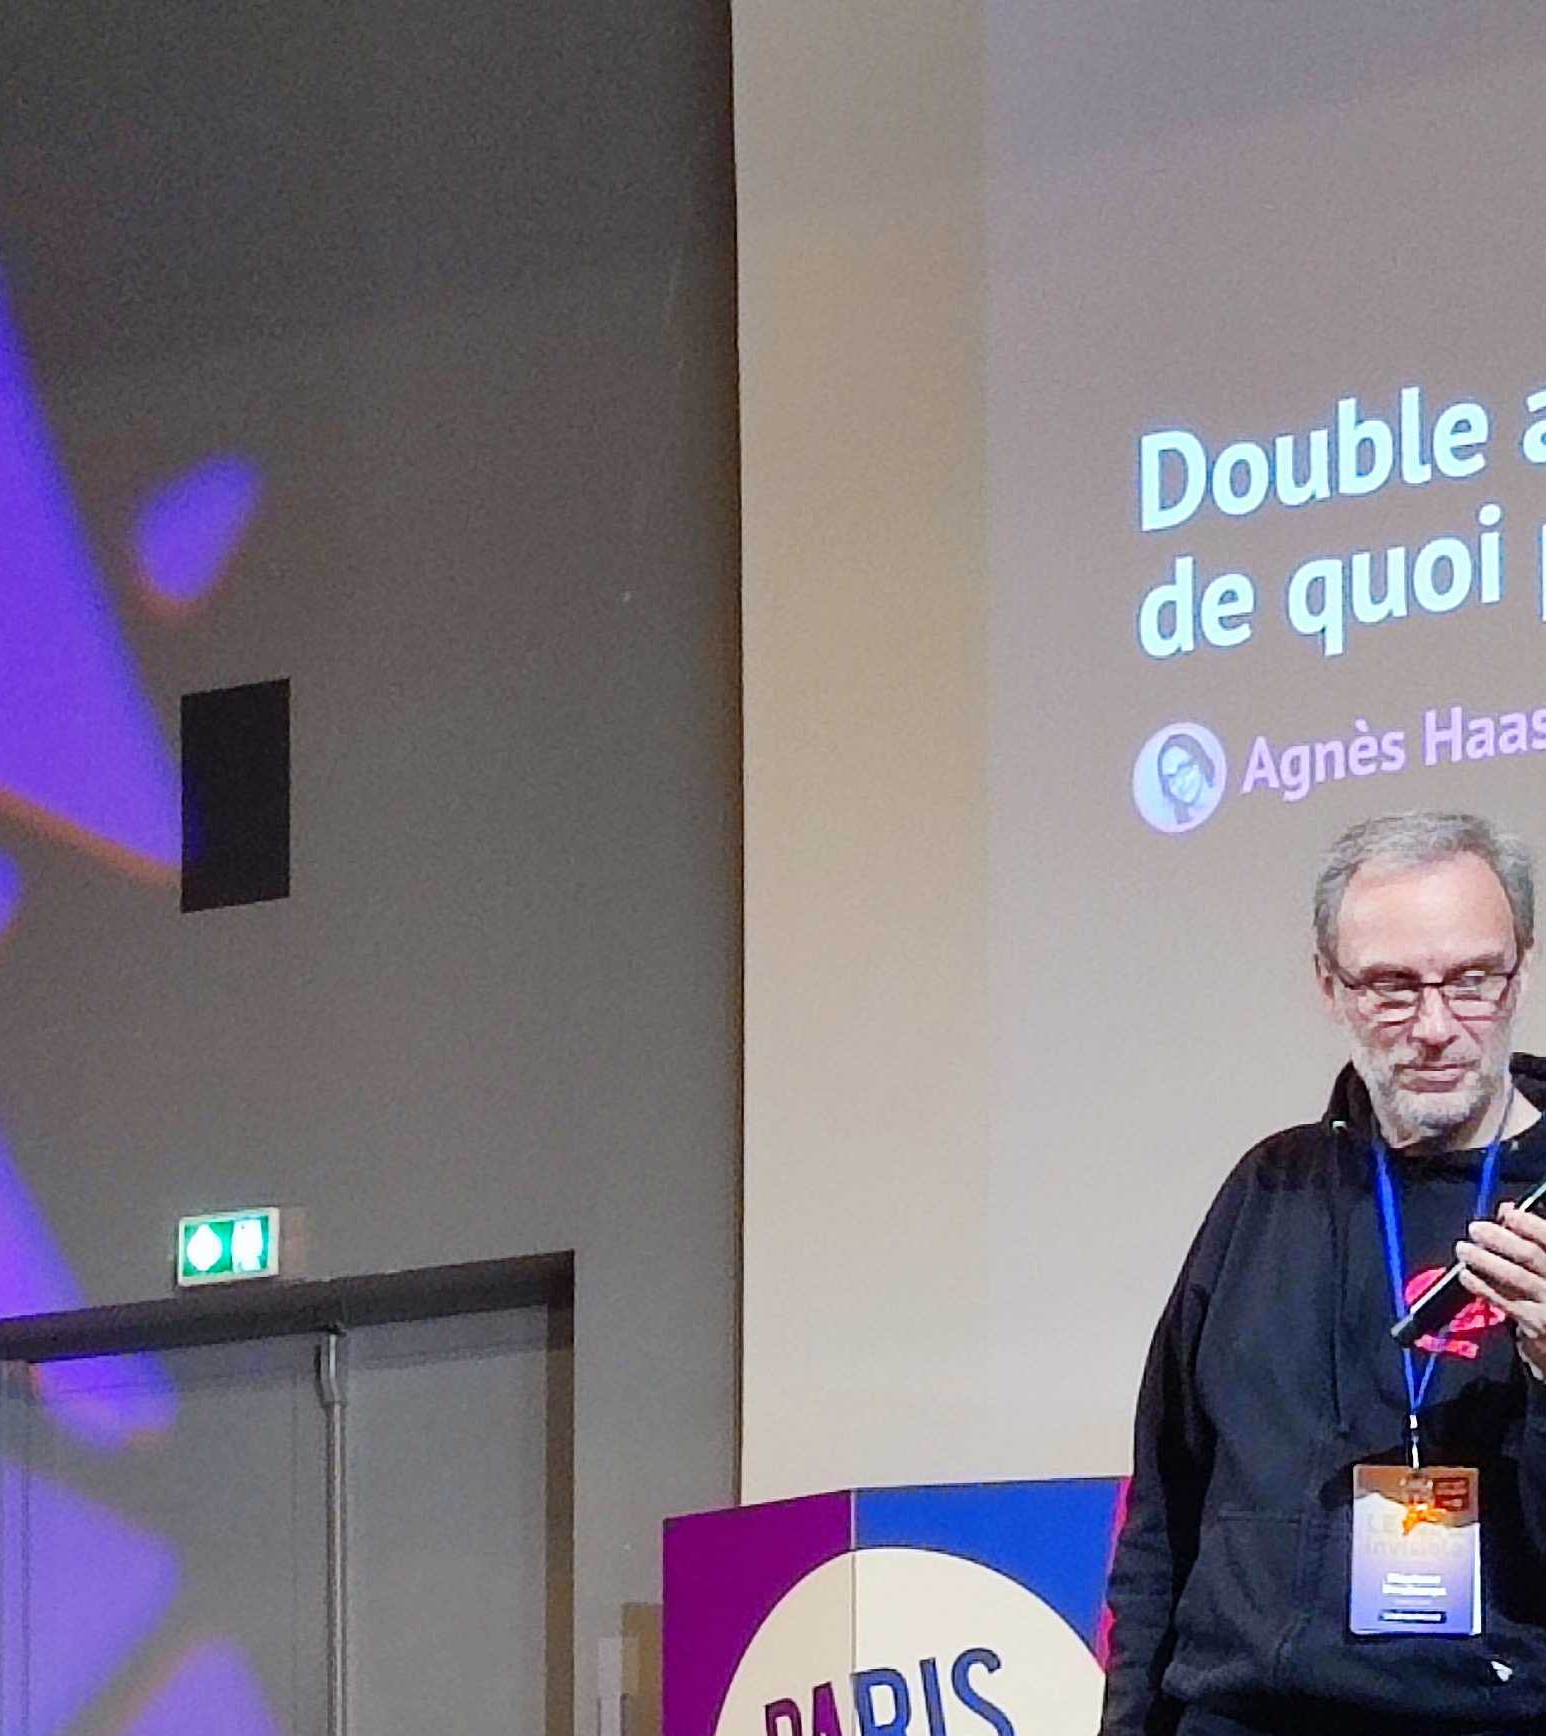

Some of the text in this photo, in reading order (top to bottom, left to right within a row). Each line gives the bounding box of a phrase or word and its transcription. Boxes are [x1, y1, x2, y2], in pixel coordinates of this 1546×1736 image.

[1139, 386, 1489, 532] Double
[1138, 555, 1256, 658] de
[1286, 503, 1502, 657] quoi
[1241, 718, 1407, 802] Agnès
